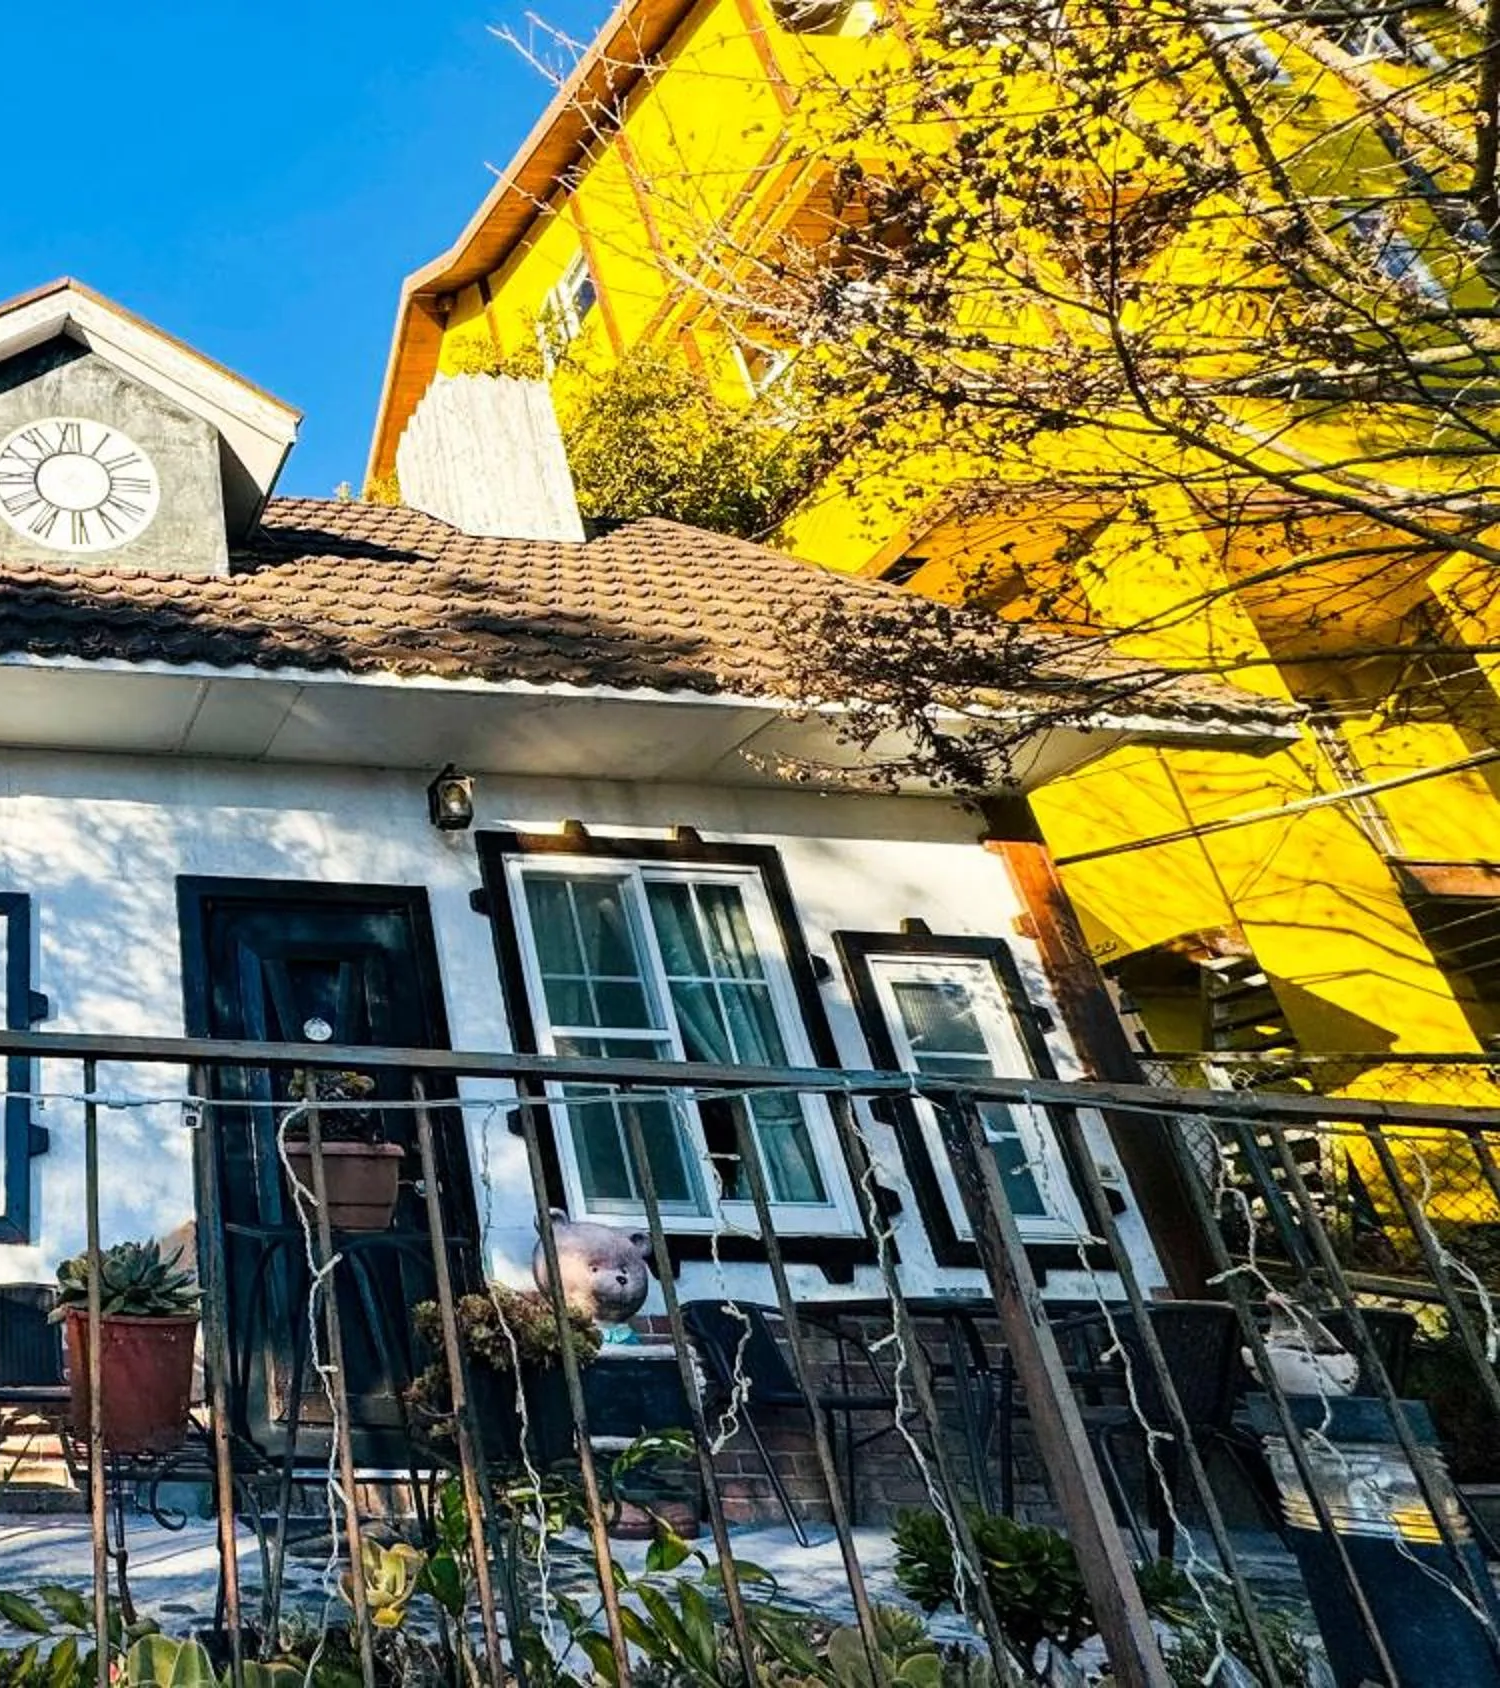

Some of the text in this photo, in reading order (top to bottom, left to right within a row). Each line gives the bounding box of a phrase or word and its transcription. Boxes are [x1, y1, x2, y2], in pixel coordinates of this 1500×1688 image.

[55, 422, 82, 453] XII
[1, 445, 42, 468] X
[102, 452, 142, 472] II
[109, 477, 150, 494] III
[107, 495, 146, 522] IV
[71, 511, 90, 545] VI
[97, 508, 126, 539] V
